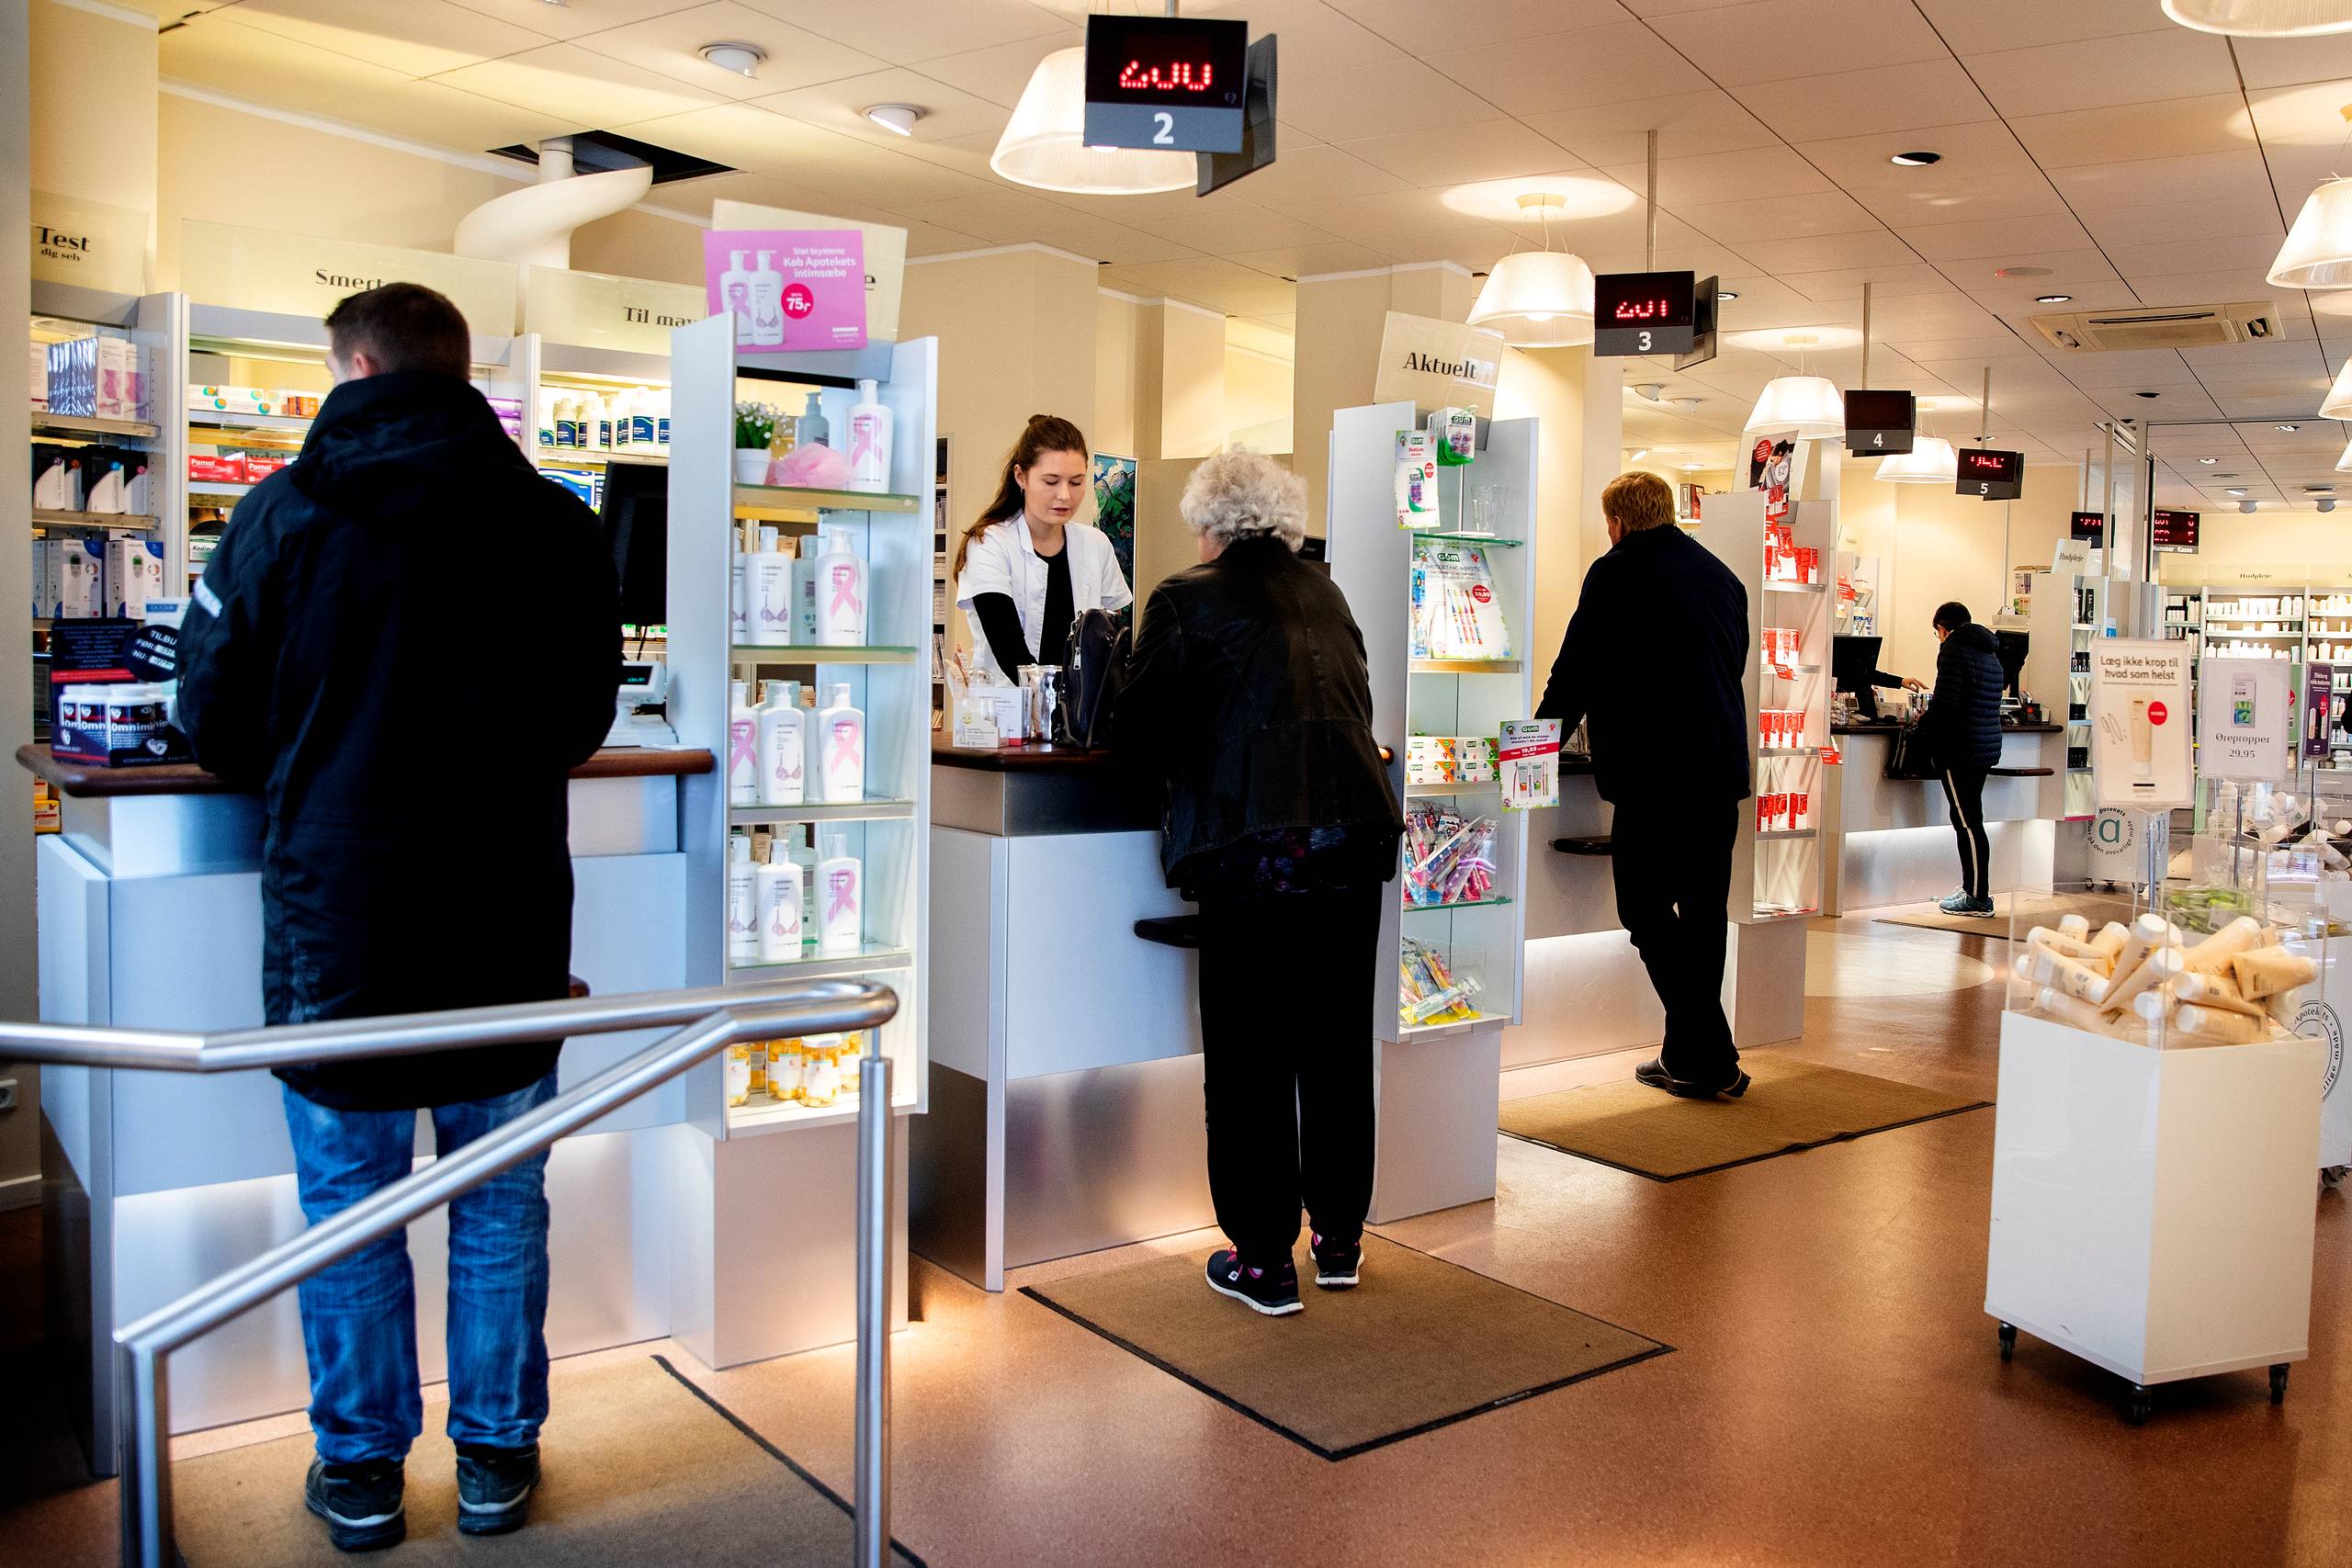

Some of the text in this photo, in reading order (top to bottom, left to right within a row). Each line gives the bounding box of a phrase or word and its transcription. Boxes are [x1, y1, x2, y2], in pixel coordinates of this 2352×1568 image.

[1153, 112, 1174, 144] 2
[37, 226, 90, 252] Test
[41, 248, 81, 261] dig selv
[805, 257, 856, 268] Apotekets
[315, 268, 384, 290] Smert
[786, 297, 811, 312] 75,-
[623, 307, 650, 323] Til
[1638, 331, 1652, 351] 3
[1403, 352, 1477, 379] Aktuelt
[1873, 433, 1883, 447] 4
[191, 458, 215, 467] Pamol
[249, 463, 272, 471] Pamol
[1980, 482, 1989, 494] 5
[150, 630, 177, 646] TILBU
[2100, 656, 2120, 669] Læg
[2123, 656, 2143, 667] ikke
[2145, 657, 2166, 669] krop
[2168, 657, 2179, 668] til
[2105, 669, 2127, 680] hvad
[2153, 670, 2176, 680] helst
[2215, 732, 2270, 745] Ørepropper
[2229, 749, 2256, 760] 29.95
[2098, 807, 2126, 817] potekets
[2294, 1007, 2329, 1024] Apotekts
